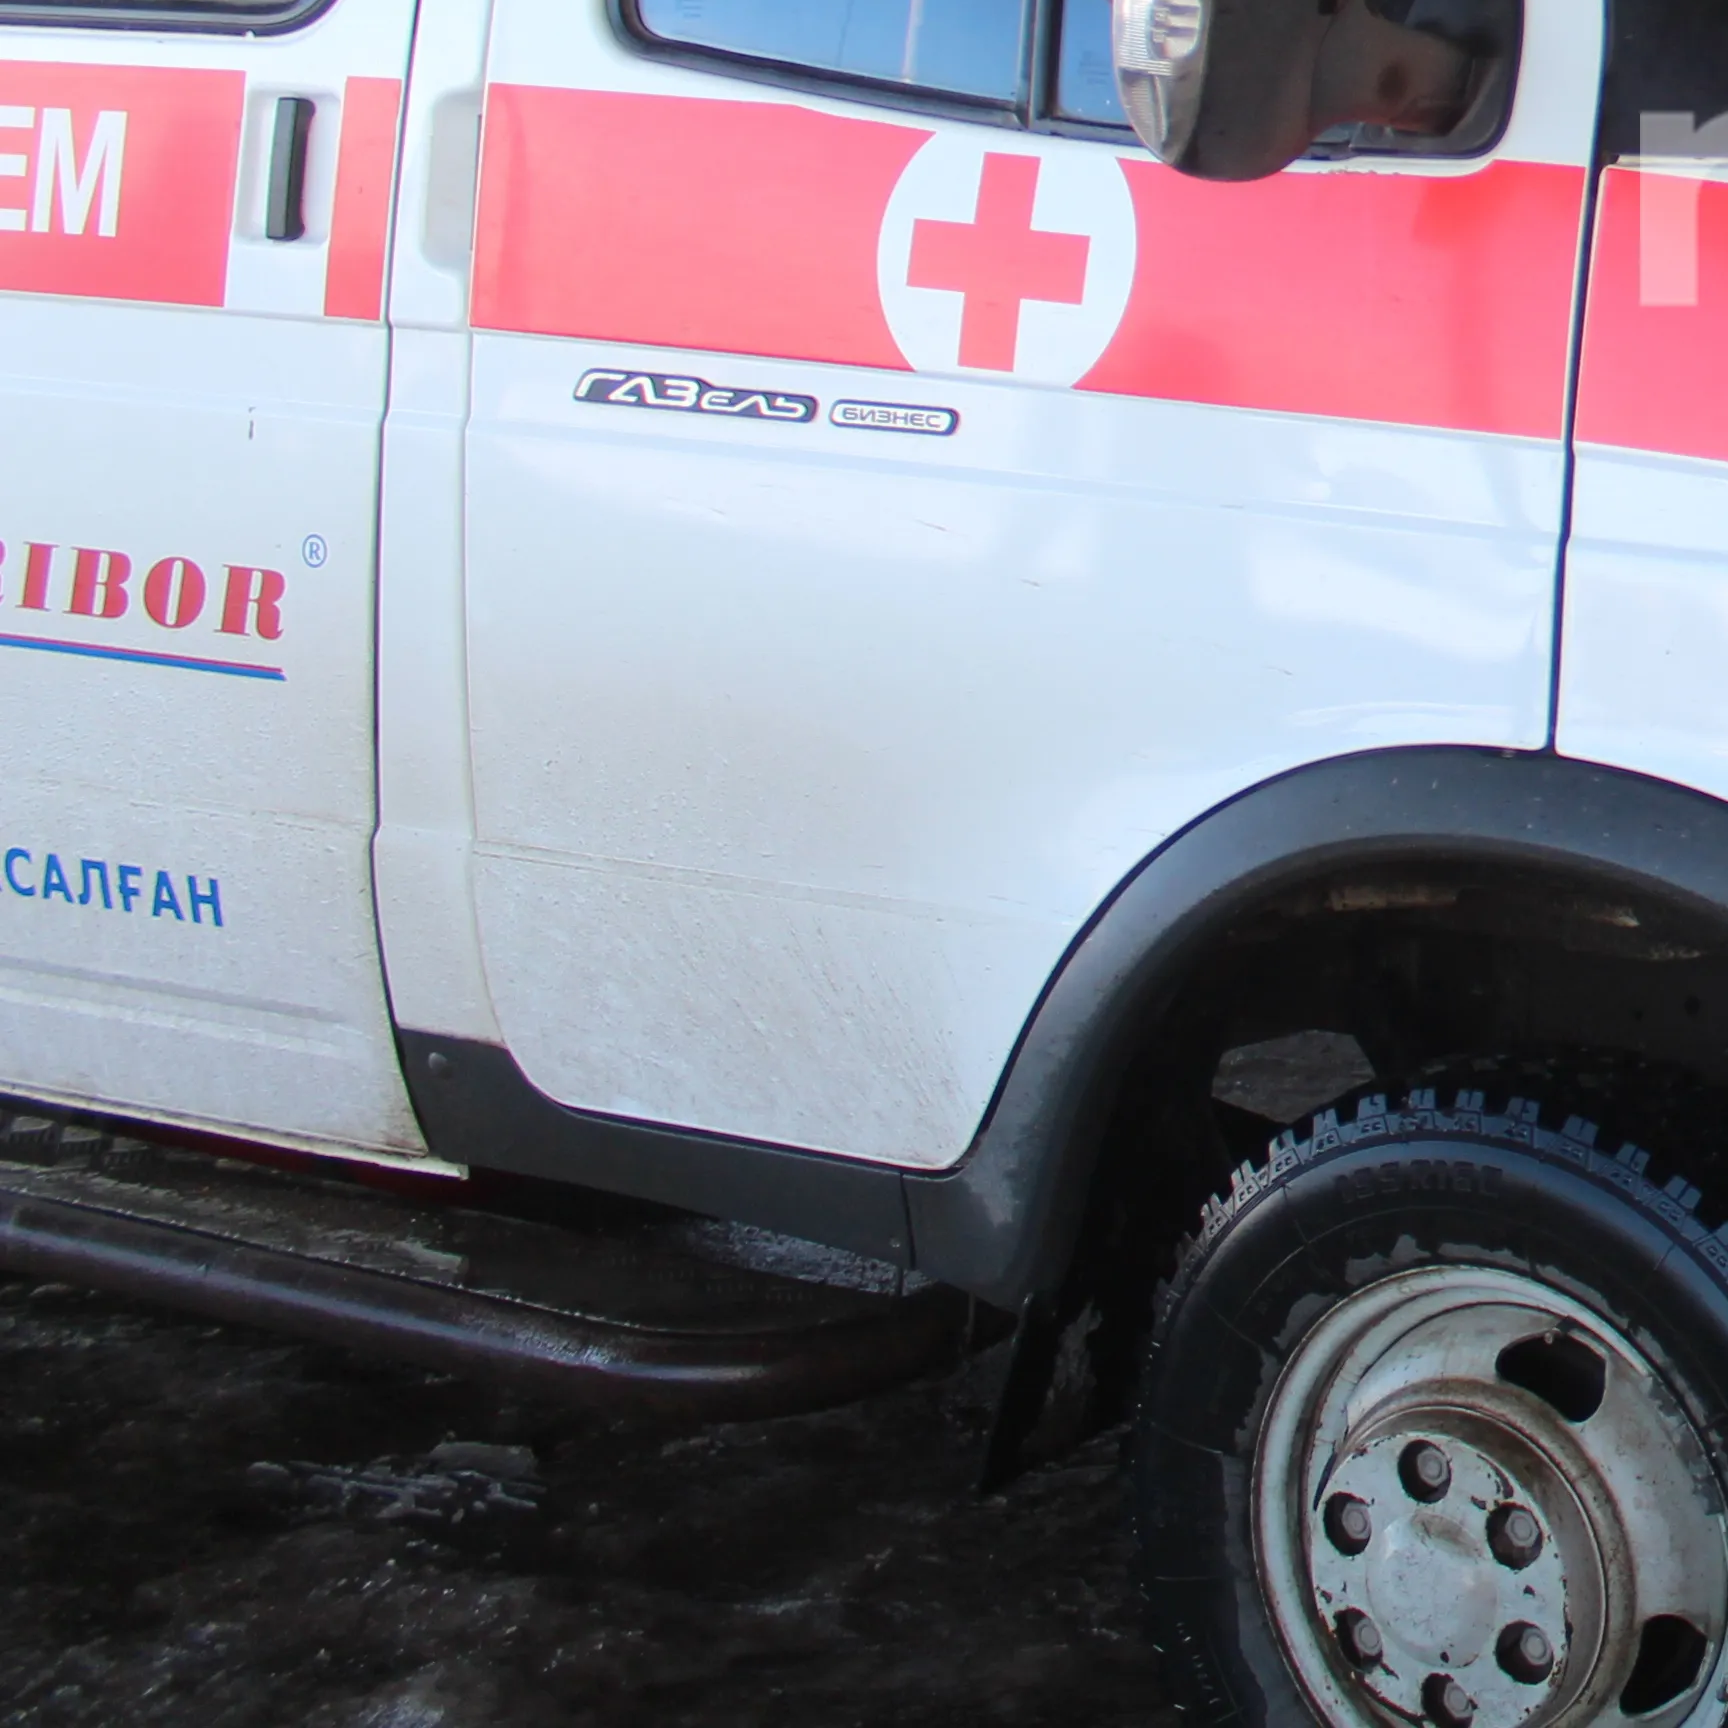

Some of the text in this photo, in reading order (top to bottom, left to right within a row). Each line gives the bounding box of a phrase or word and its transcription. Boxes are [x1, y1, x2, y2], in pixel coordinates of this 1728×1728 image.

[841, 406, 942, 429] БИЗНЕС
[0, 539, 285, 641] IBOR
[0, 847, 224, 927] САЛҒАН
